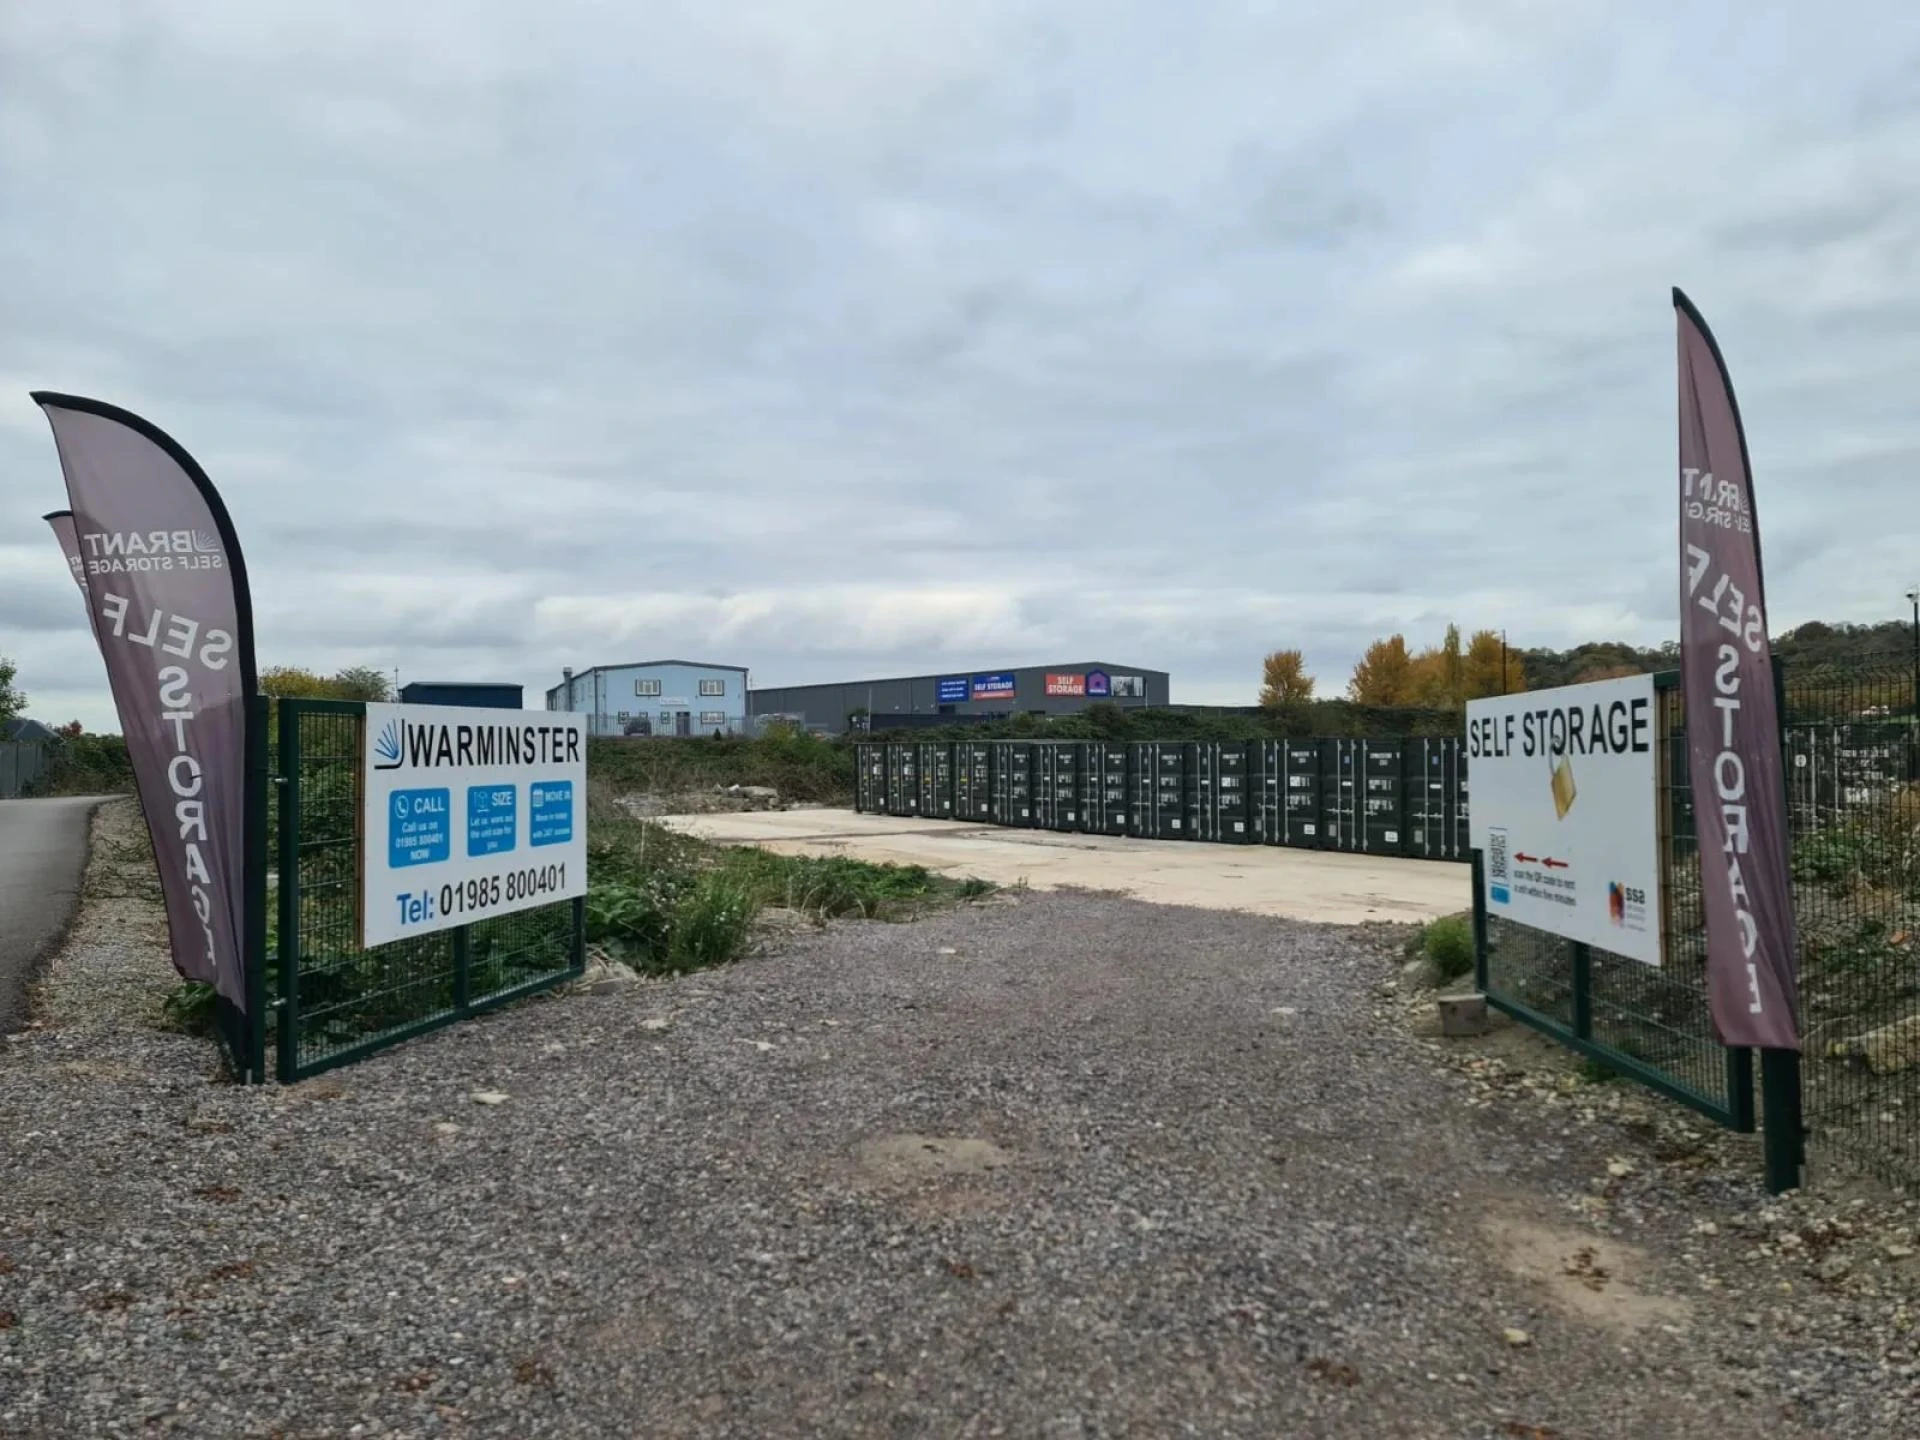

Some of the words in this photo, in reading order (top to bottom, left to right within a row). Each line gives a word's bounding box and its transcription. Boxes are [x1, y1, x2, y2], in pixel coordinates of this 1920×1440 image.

[1057, 675, 1074, 684] SELF
[1047, 684, 1084, 695] STORAGE
[1470, 715, 1515, 758] SELF
[1523, 698, 1649, 757] STORAGE
[408, 724, 580, 767] WARMINSTER
[414, 796, 445, 814] CALL
[491, 791, 512, 806] SIZE
[397, 890, 434, 925] Tel:
[440, 876, 500, 916] 01985
[506, 862, 565, 902] 800401
[1626, 887, 1645, 905] ssa
